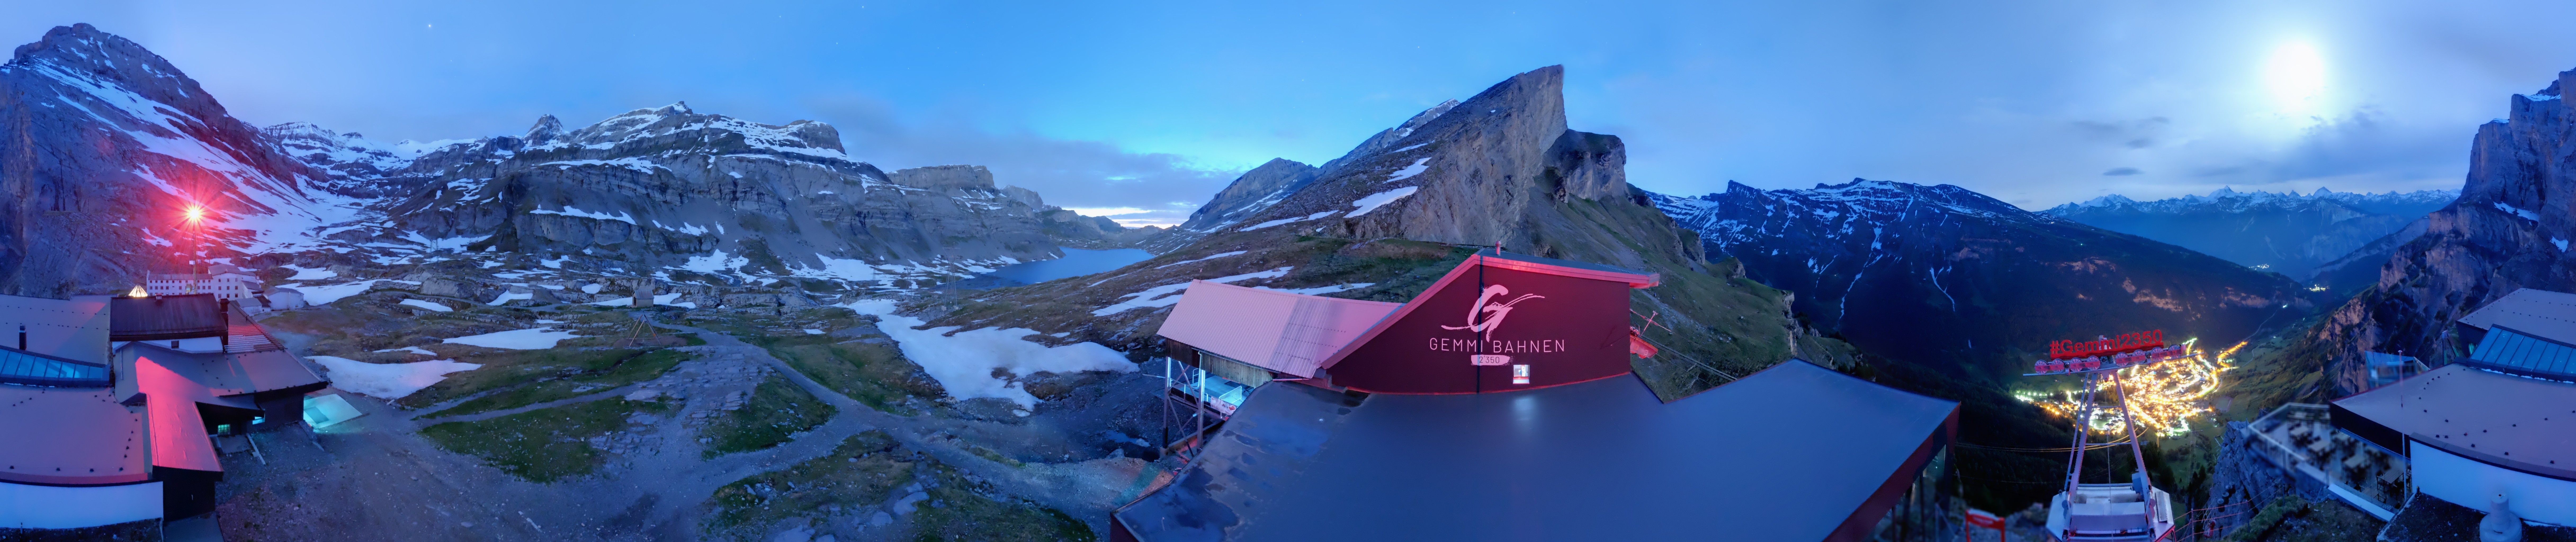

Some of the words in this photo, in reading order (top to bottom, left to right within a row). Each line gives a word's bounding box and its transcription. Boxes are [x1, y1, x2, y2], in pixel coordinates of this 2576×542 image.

[1430, 338, 1482, 352] GEMMI
[1493, 340, 1564, 353] BAHNEN
[2050, 329, 2162, 354] #Gemmi2350
